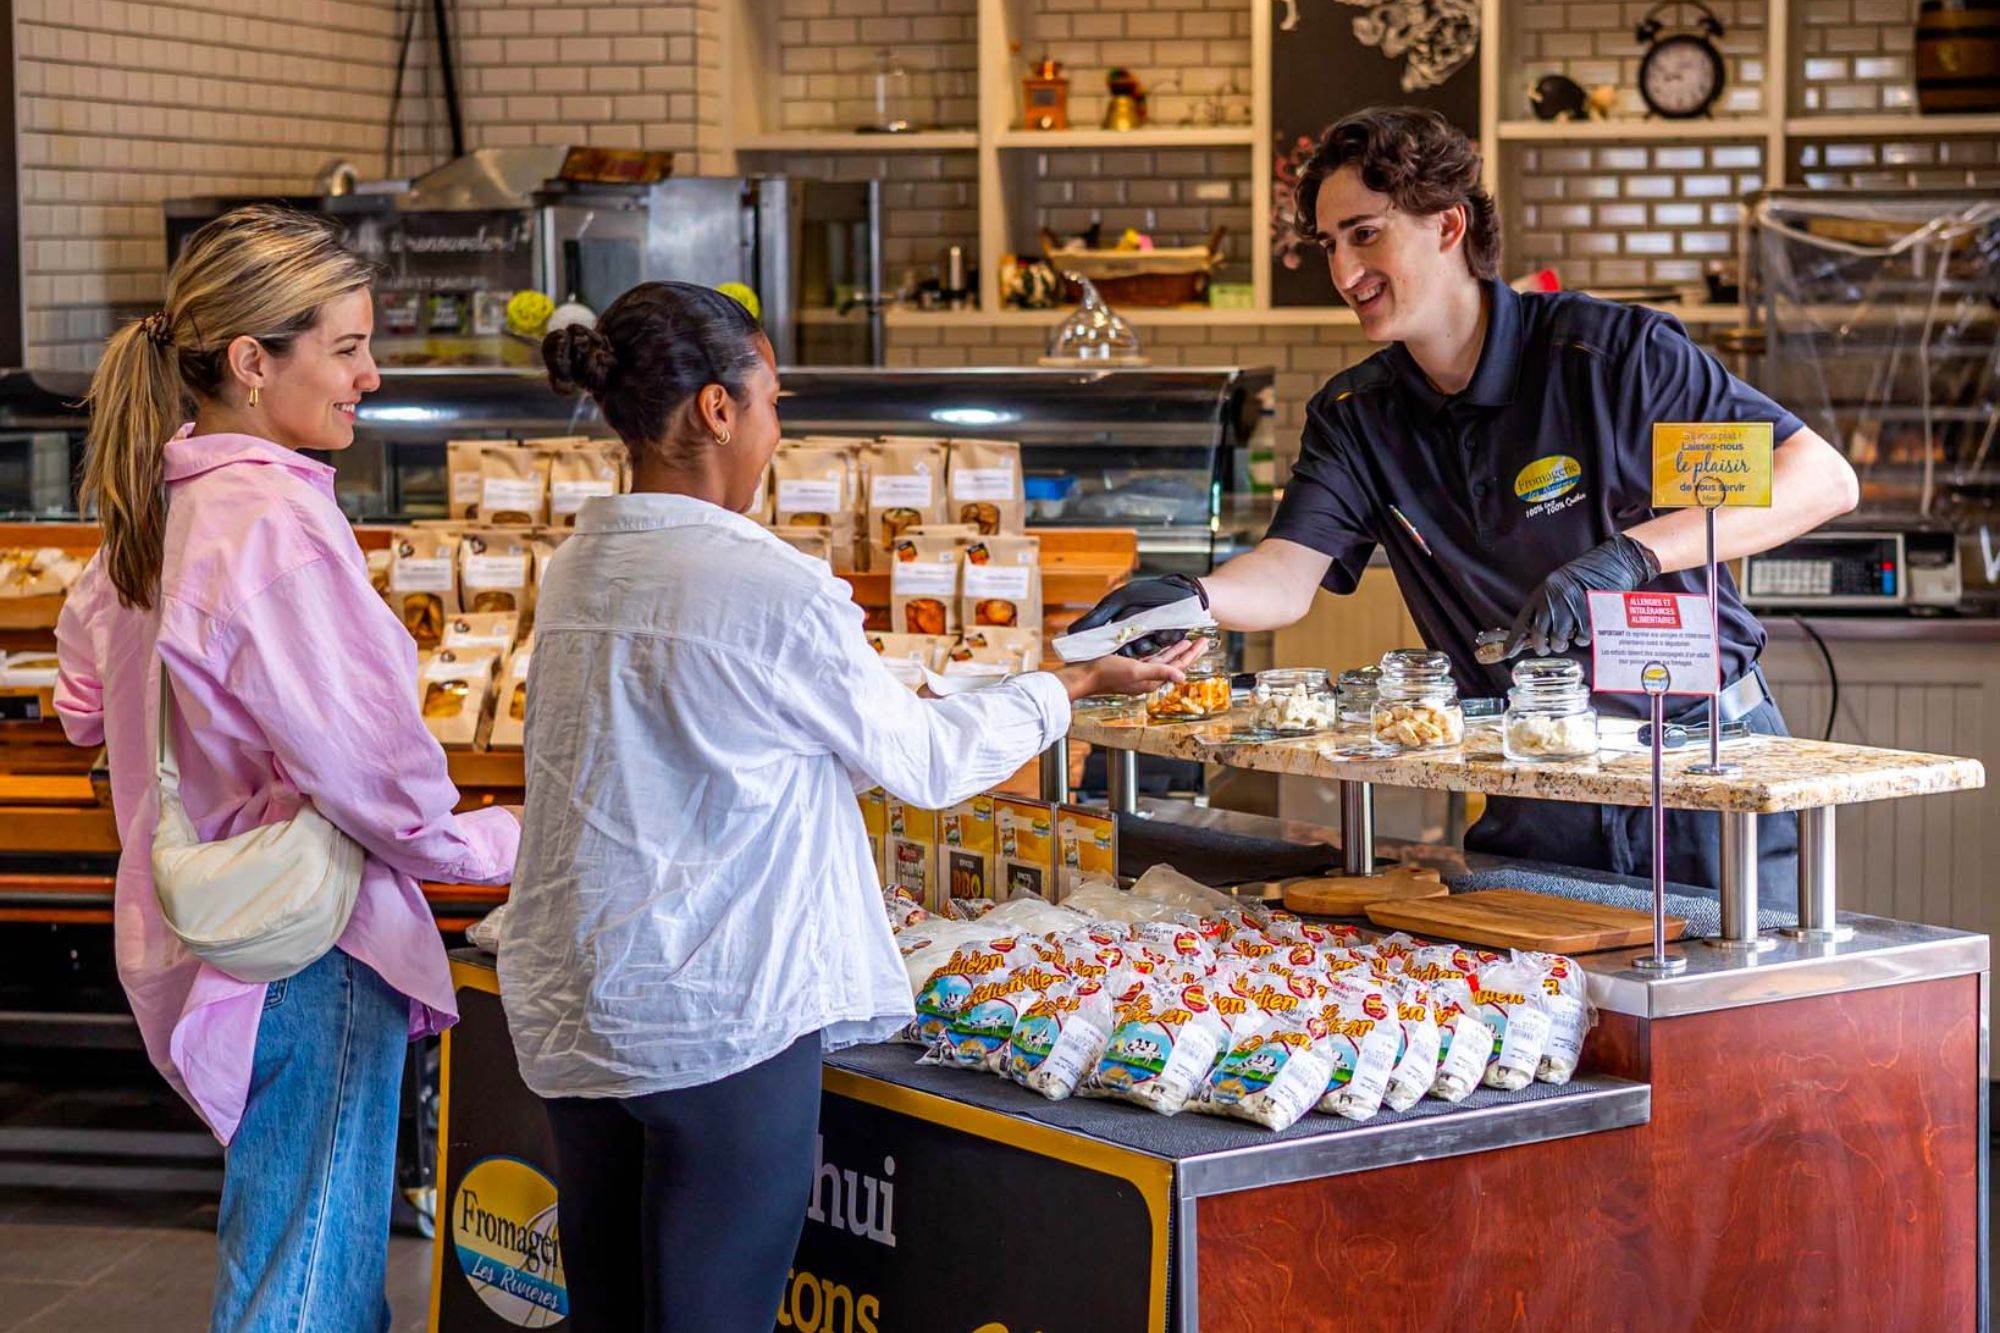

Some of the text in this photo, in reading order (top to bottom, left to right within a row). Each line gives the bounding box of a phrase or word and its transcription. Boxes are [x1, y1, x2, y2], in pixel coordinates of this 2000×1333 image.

[1681, 442, 1745, 451] Laissez-nous
[1676, 451, 1751, 483] le plaisir
[1518, 463, 1578, 492] Fromagerie
[1679, 482, 1692, 492] de
[1629, 598, 1671, 607] ALLERGIES ET
[1631, 615, 1677, 624] ALIMENTAIRES
[471, 1255, 495, 1282] Les
